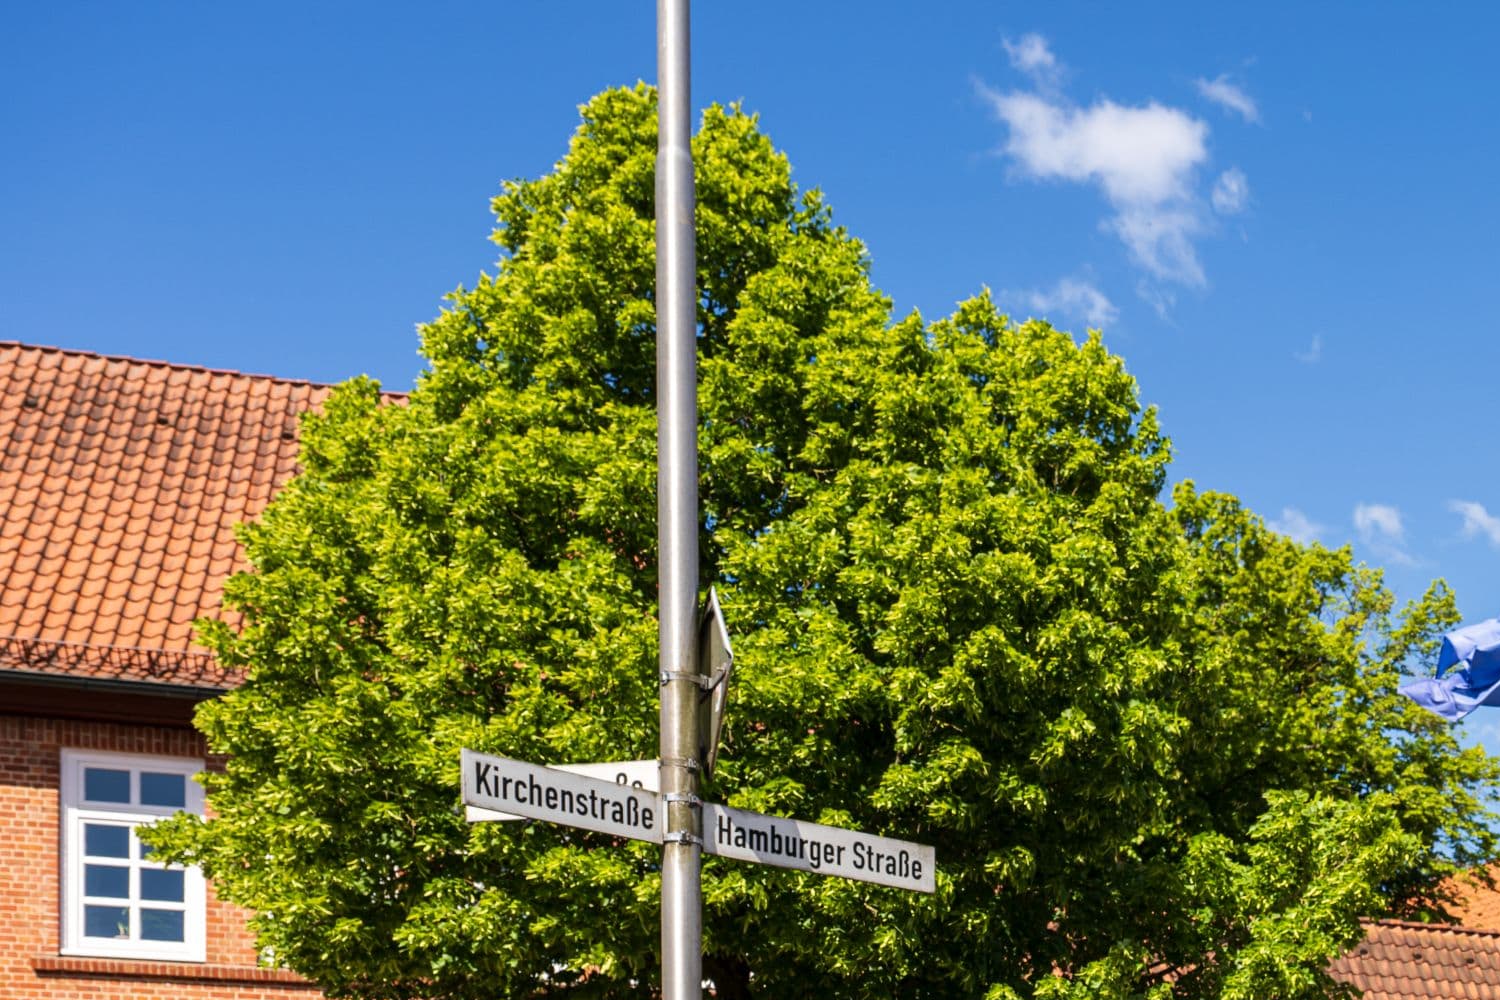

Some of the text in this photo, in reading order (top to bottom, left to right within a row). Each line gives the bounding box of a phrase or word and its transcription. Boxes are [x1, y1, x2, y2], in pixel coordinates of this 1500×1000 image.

[475, 762, 654, 829] Kirchenstraße
[718, 815, 923, 880] Hamburger Straße
